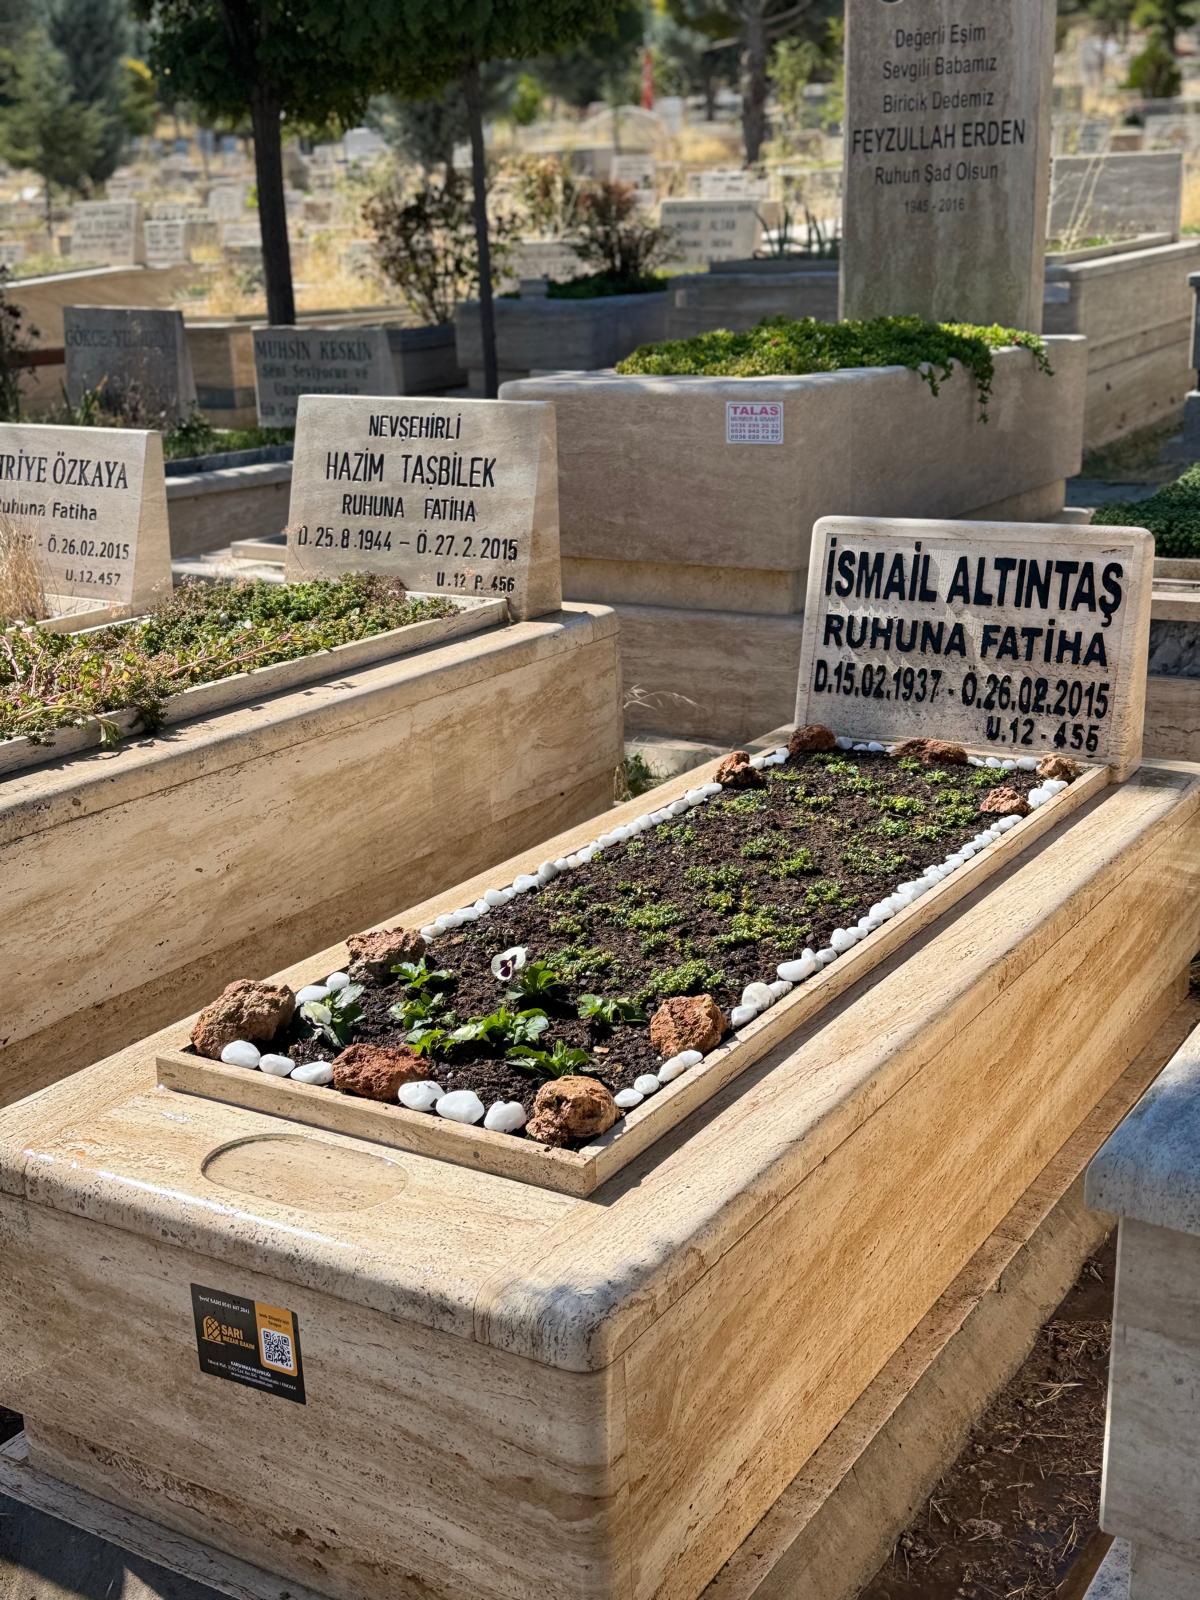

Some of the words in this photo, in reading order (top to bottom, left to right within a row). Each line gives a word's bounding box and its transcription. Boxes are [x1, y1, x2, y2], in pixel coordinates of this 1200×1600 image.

[896, 26, 944, 51] Değerli
[950, 24, 986, 47] Eşim
[883, 58, 930, 82] Sevgili
[935, 56, 997, 76] Babamız
[883, 94, 927, 113] Biricik
[933, 88, 994, 110] Dedemiz
[853, 124, 955, 154] FEYZULLAH
[962, 119, 1025, 147] ERDEN
[875, 166, 920, 185] Ruhun
[925, 163, 951, 187] Şad
[956, 161, 998, 181] Olsun
[905, 199, 929, 213] 1945
[940, 198, 965, 212] 2016
[256, 335, 311, 360] MUHSİN
[320, 337, 372, 360] KESKİN
[731, 406, 778, 416] TALAS
[369, 412, 462, 442] NEVŞEHİRLİ
[53, 451, 129, 489] ÖZKAYA
[325, 447, 385, 482] HAZİM
[401, 452, 497, 490] TAŞBİLEK
[52, 502, 98, 521] Fatiha
[342, 494, 405, 518] RUHUNA
[424, 496, 477, 522] FATİHA
[48, 533, 130, 560] Ö.26.02.2015
[298, 526, 392, 552] D.25.8.1944
[417, 530, 518, 561] Ö.27.2.2015
[65, 569, 122, 586] U.12.457
[491, 575, 515, 592] 456
[825, 537, 938, 602] İSMAİL
[946, 555, 1124, 628] ALTINTAŞ
[823, 613, 967, 657] RUHUNA
[980, 619, 1109, 667] FATİHA
[814, 659, 943, 704] D.15.02.1937
[962, 665, 1110, 720] Ö.26.02.2015
[986, 716, 1034, 745] U.12
[221, 1324, 244, 1340] SARI
